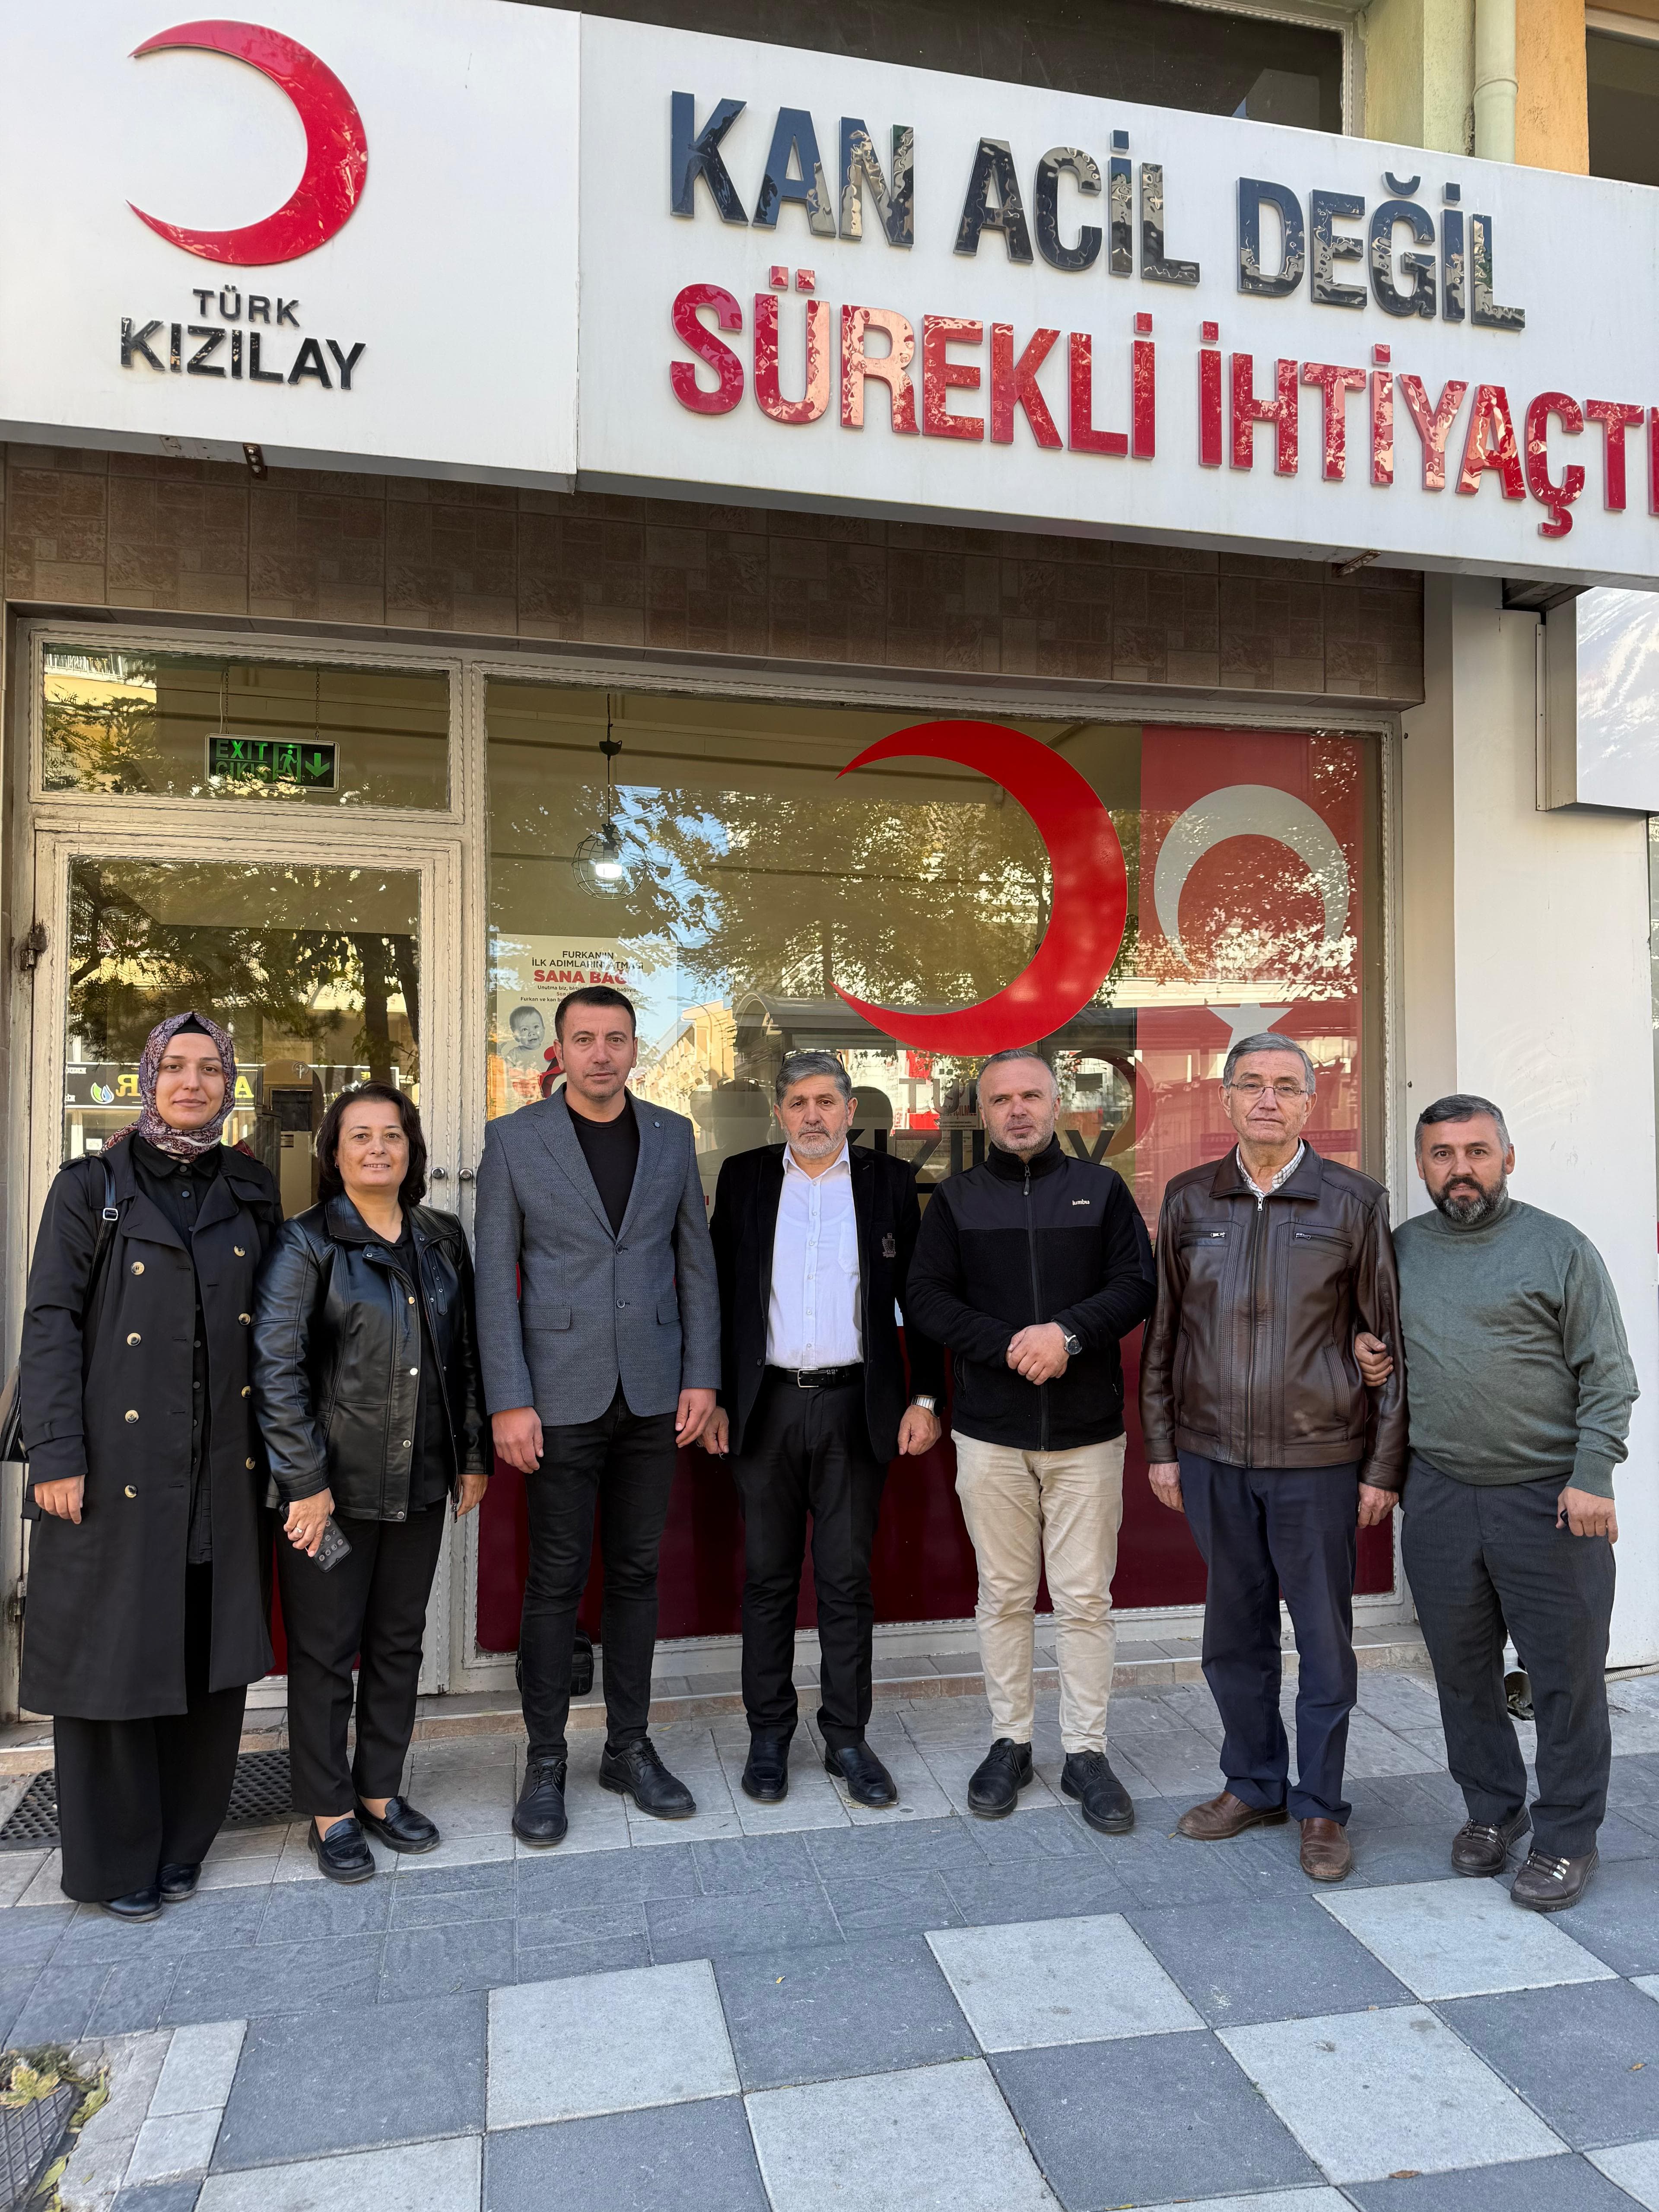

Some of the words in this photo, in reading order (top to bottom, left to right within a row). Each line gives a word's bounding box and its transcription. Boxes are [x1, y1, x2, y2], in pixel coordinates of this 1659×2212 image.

[670, 90, 914, 248] KAN
[953, 129, 1200, 286] ACİL
[1236, 172, 1526, 331] DEĞİL
[192, 284, 300, 327] TÜRK
[119, 316, 367, 391] KIZILAY
[670, 265, 1156, 461] SÜREKLİ
[216, 739, 268, 760] EXIT
[532, 957, 547, 966] İLK
[534, 969, 585, 983] SANA
